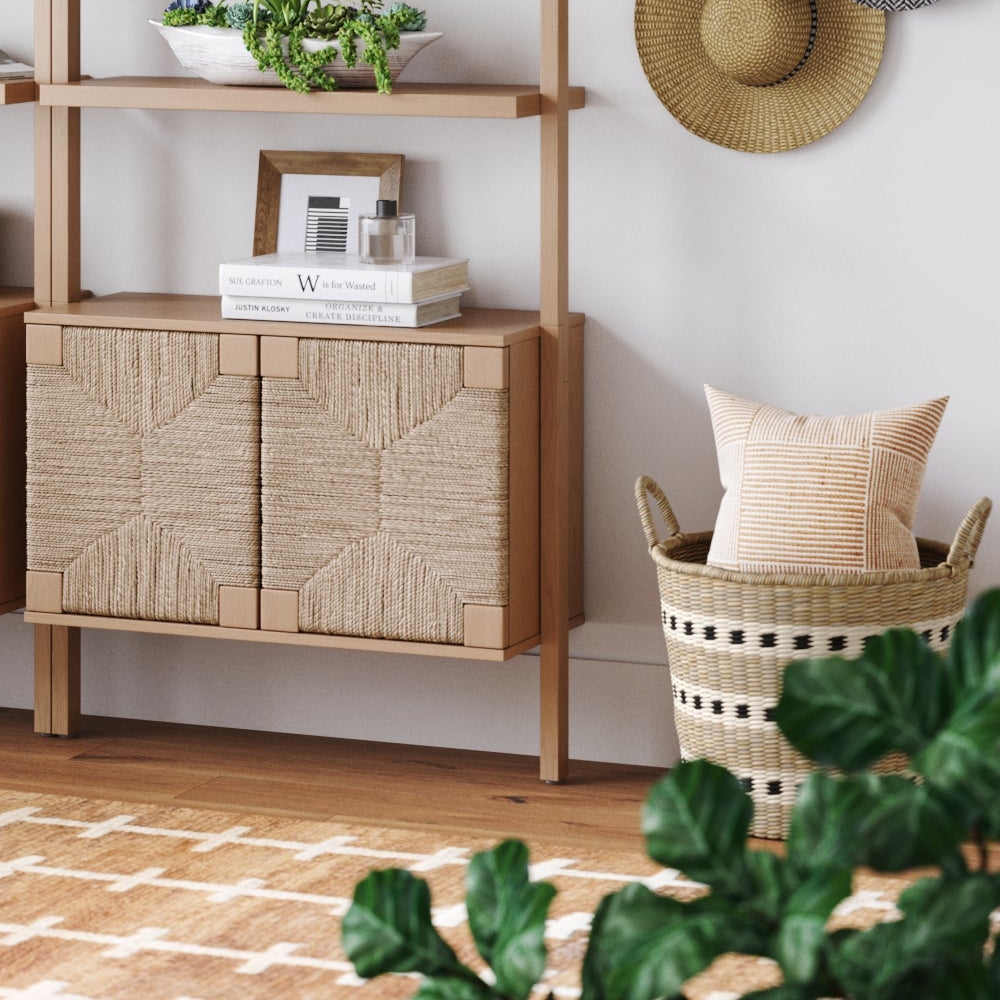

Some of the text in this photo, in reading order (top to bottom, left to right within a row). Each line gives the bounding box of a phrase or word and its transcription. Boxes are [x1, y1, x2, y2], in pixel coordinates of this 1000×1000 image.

[229, 277, 282, 287] SUE GRAFTON
[297, 274, 320, 293] W
[331, 281, 343, 289] for
[344, 281, 376, 291] Wasted
[235, 304, 290, 313] JUSTIN KLOSKY
[325, 302, 384, 312] ORGANIZE &
[305, 312, 401, 323] CREATE DISCIPLINE
